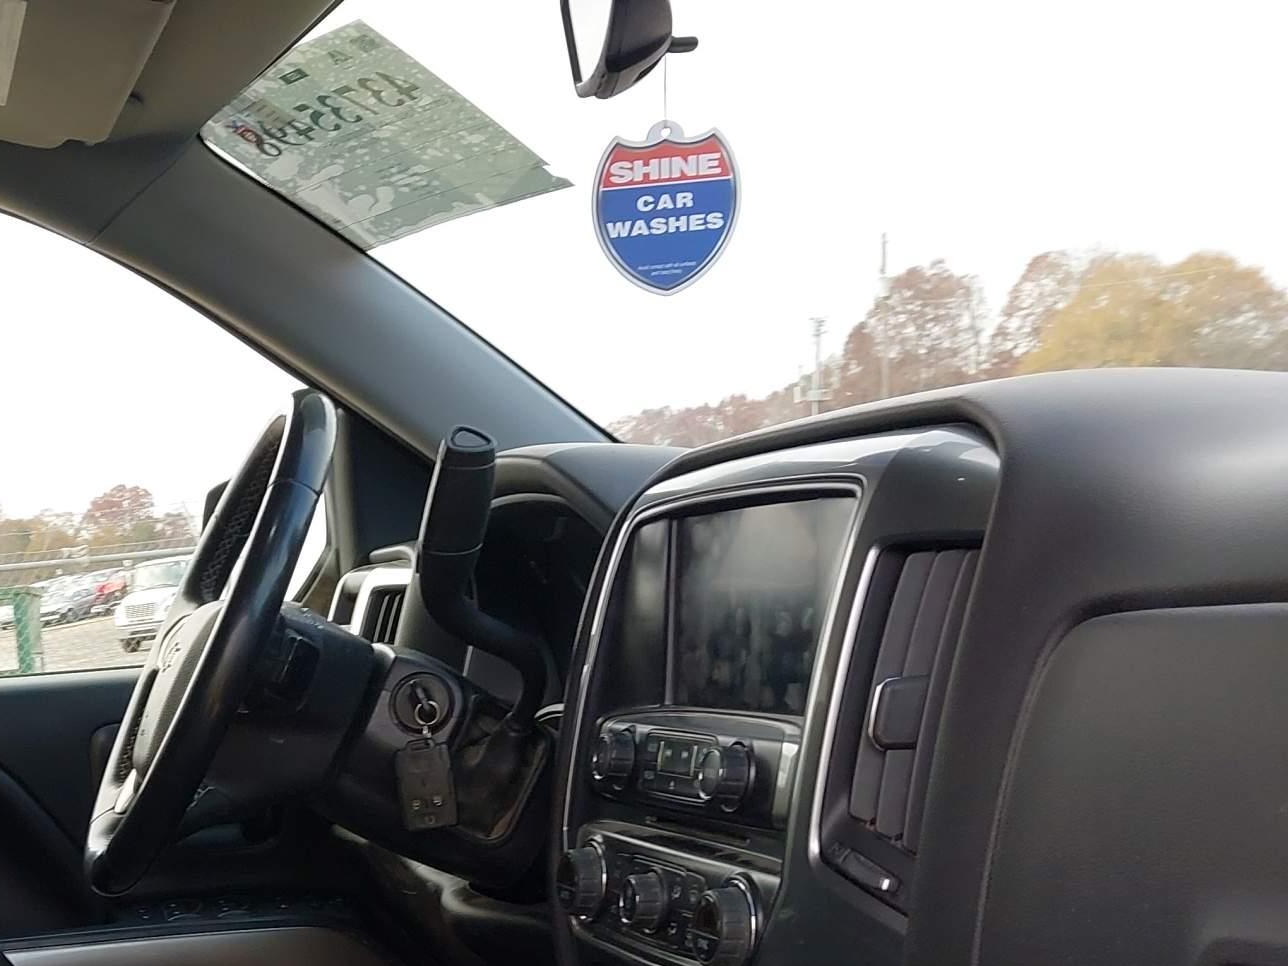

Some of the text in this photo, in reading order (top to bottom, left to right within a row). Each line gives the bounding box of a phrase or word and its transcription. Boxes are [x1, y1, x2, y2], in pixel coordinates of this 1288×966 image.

[609, 151, 722, 184] SHINE
[636, 192, 694, 212] CAR
[606, 212, 725, 239] WASHES
